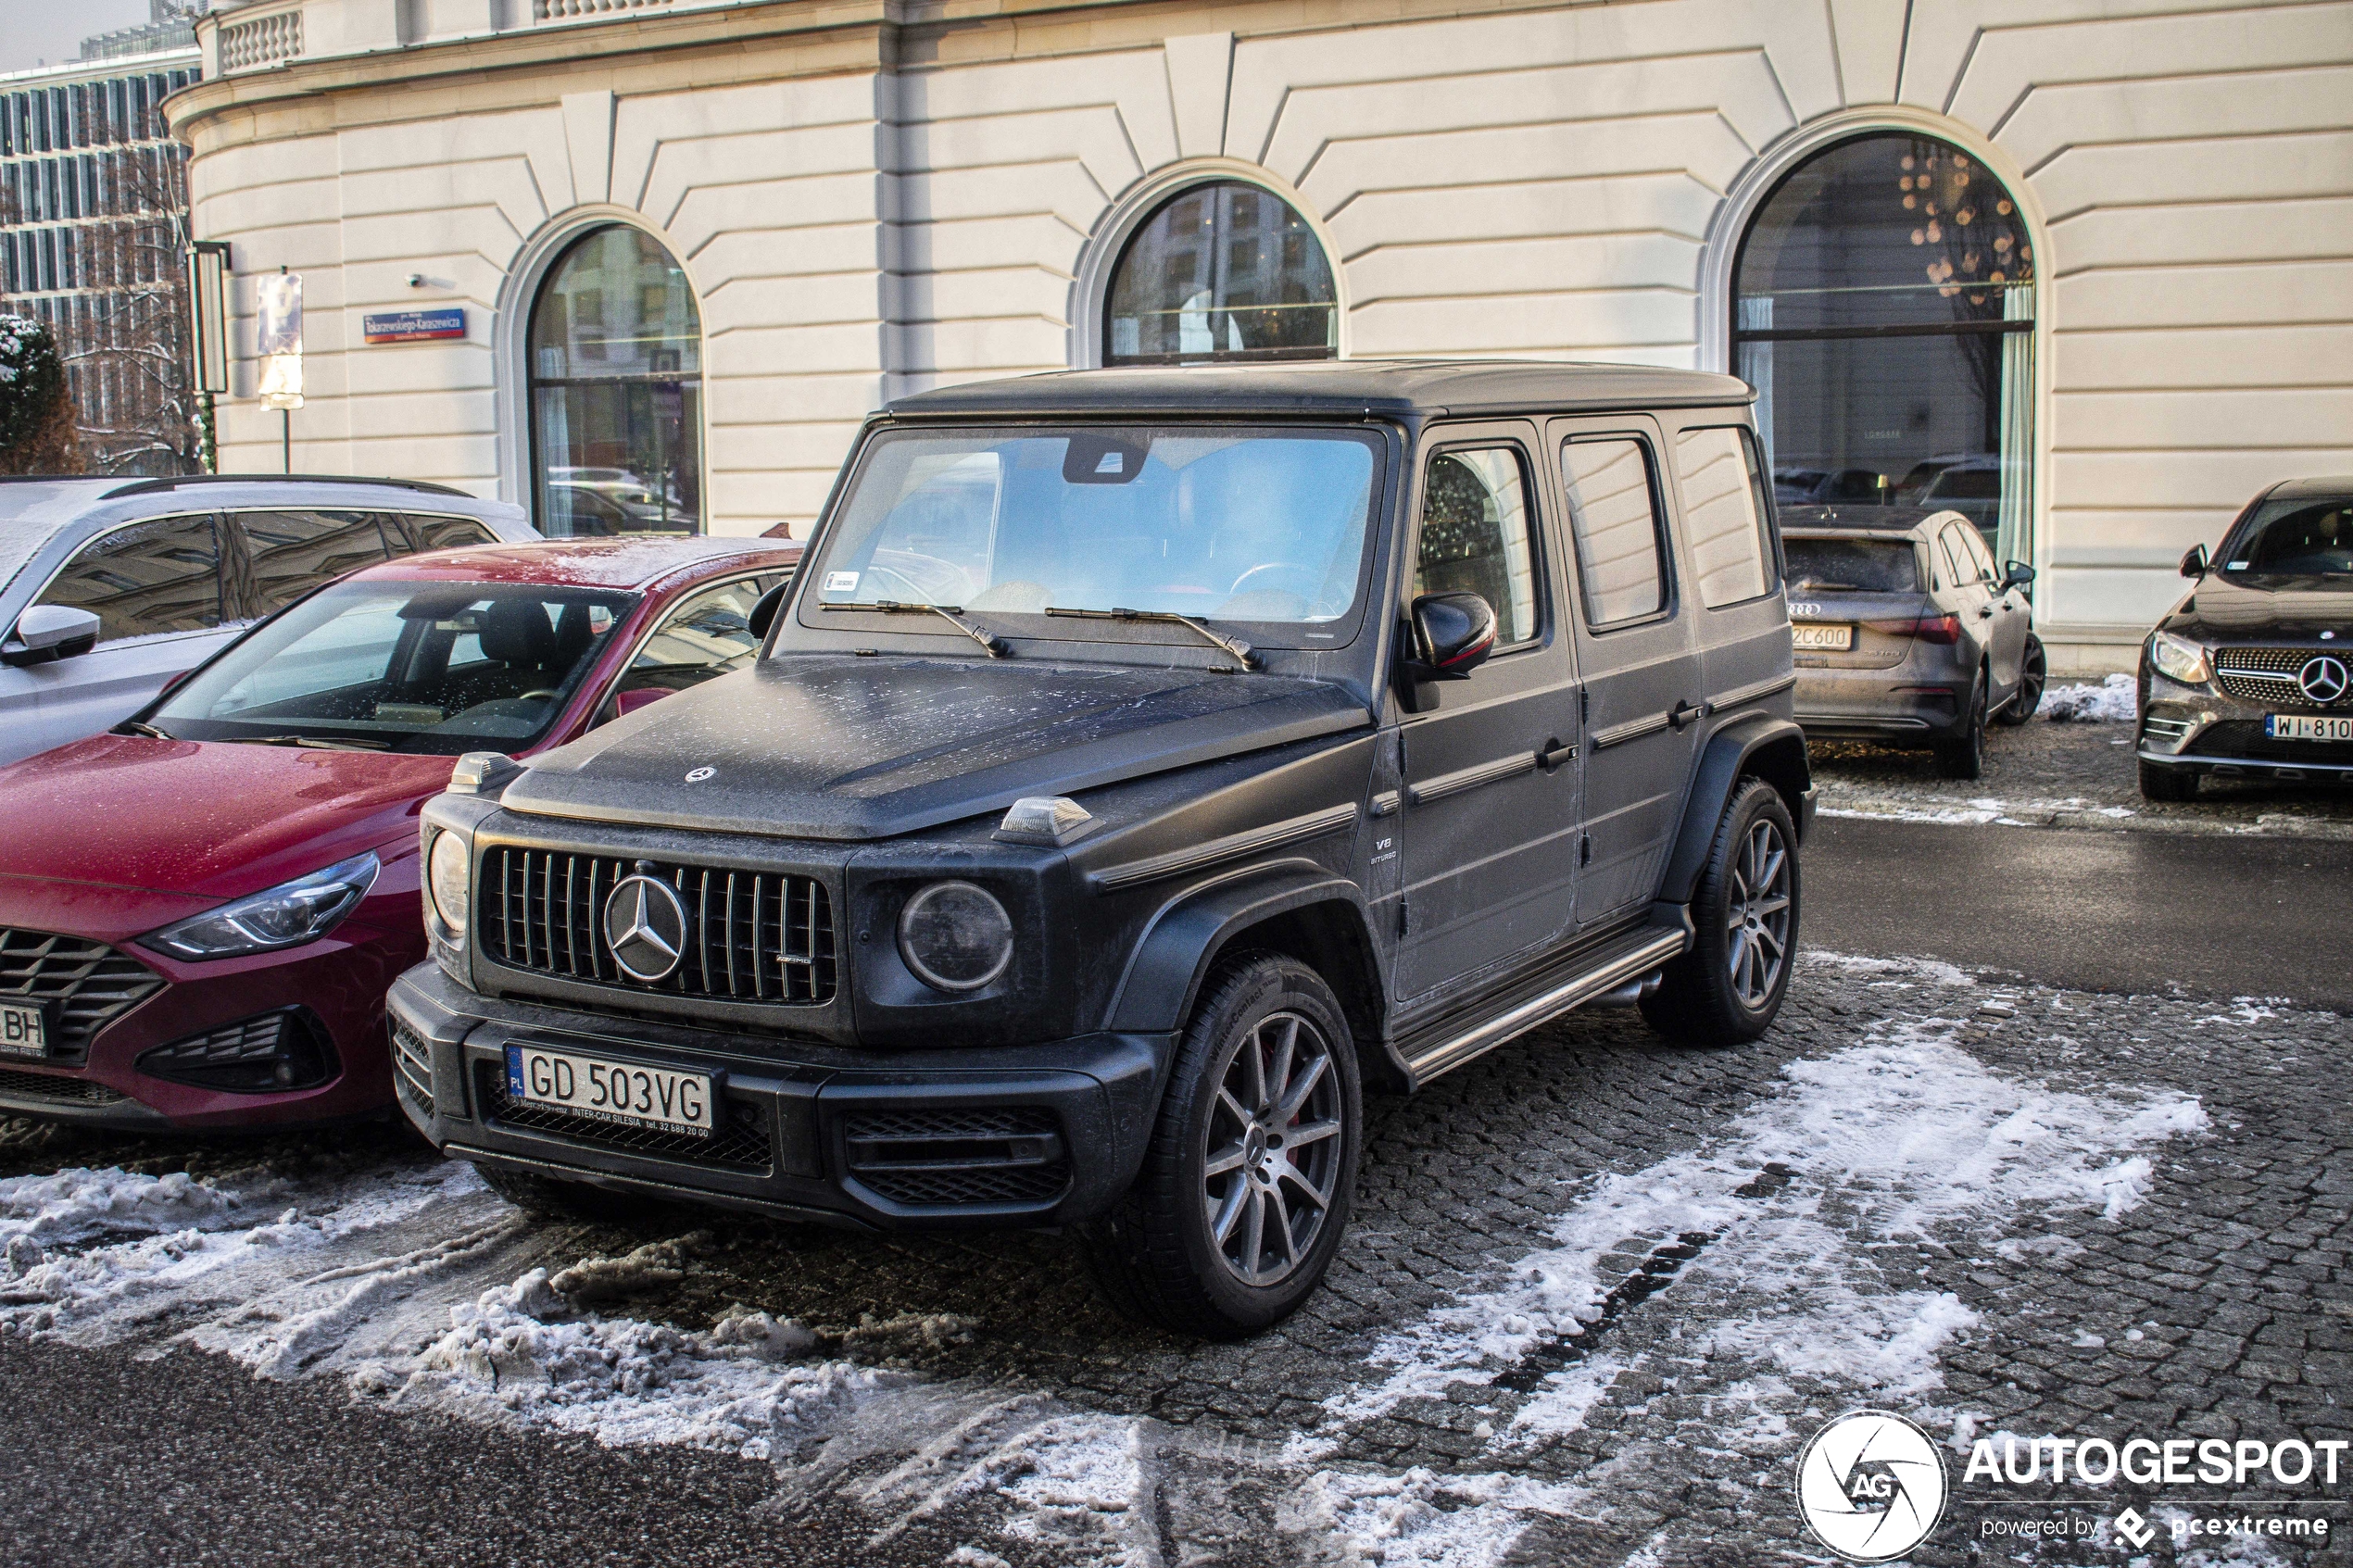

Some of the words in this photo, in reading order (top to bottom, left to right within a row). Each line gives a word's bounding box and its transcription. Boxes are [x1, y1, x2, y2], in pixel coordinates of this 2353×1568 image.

[1793, 628, 1845, 645] 2C600
[2278, 718, 2301, 735] WI
[2314, 719, 2353, 738] 810
[1376, 837, 1391, 850] V8
[1370, 850, 1397, 865] BITURBO
[4, 1010, 43, 1044] BH
[1209, 987, 1264, 1061] WinterContact
[510, 1077, 522, 1089] PL
[530, 1055, 574, 1100] GD
[589, 1063, 702, 1122] 503VG
[573, 1108, 611, 1122] INTER-CAR
[612, 1114, 641, 1127] SILESIA
[646, 1121, 658, 1129] tel.
[660, 1123, 669, 1131] 32
[686, 1126, 697, 1135] 20
[698, 1128, 709, 1137] 00
